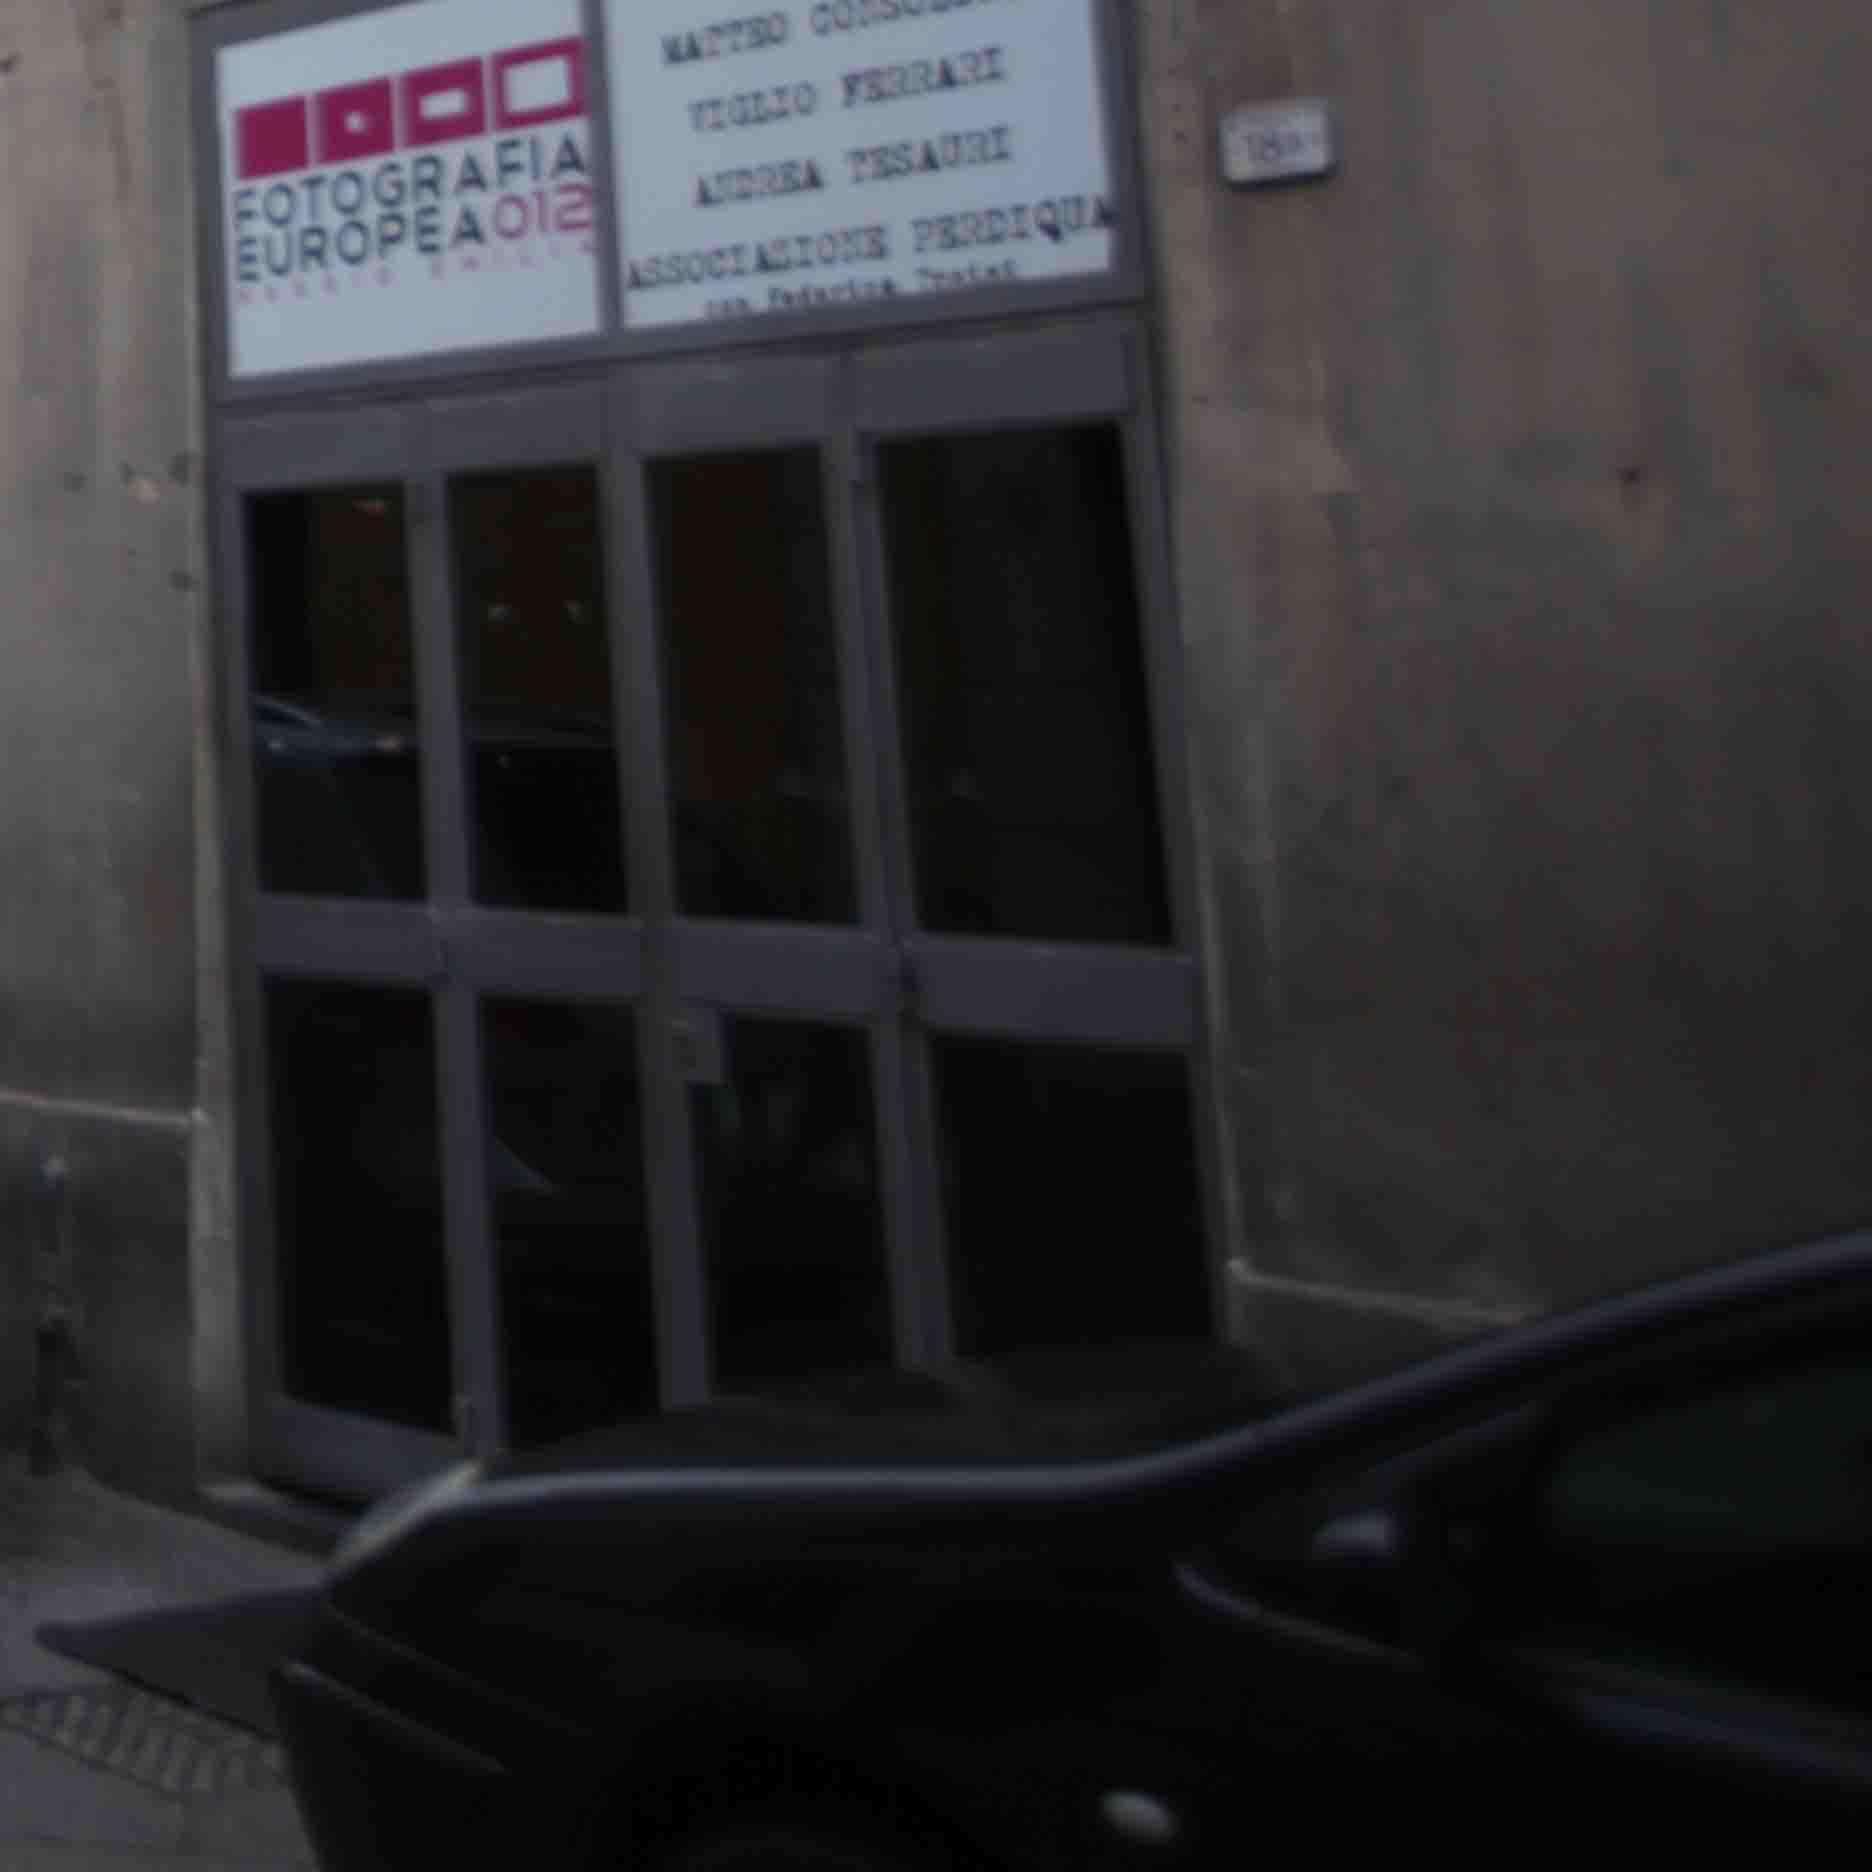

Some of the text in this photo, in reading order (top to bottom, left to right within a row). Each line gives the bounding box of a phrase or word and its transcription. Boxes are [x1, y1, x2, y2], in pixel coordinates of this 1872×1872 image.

[661, 13, 790, 66] MATTEO
[842, 48, 1006, 107] FERRARI
[234, 133, 586, 224] FOTOGRAFIA
[694, 126, 1013, 208] ANDREA TESAURI
[625, 226, 891, 292] ASSOCIAZIONE
